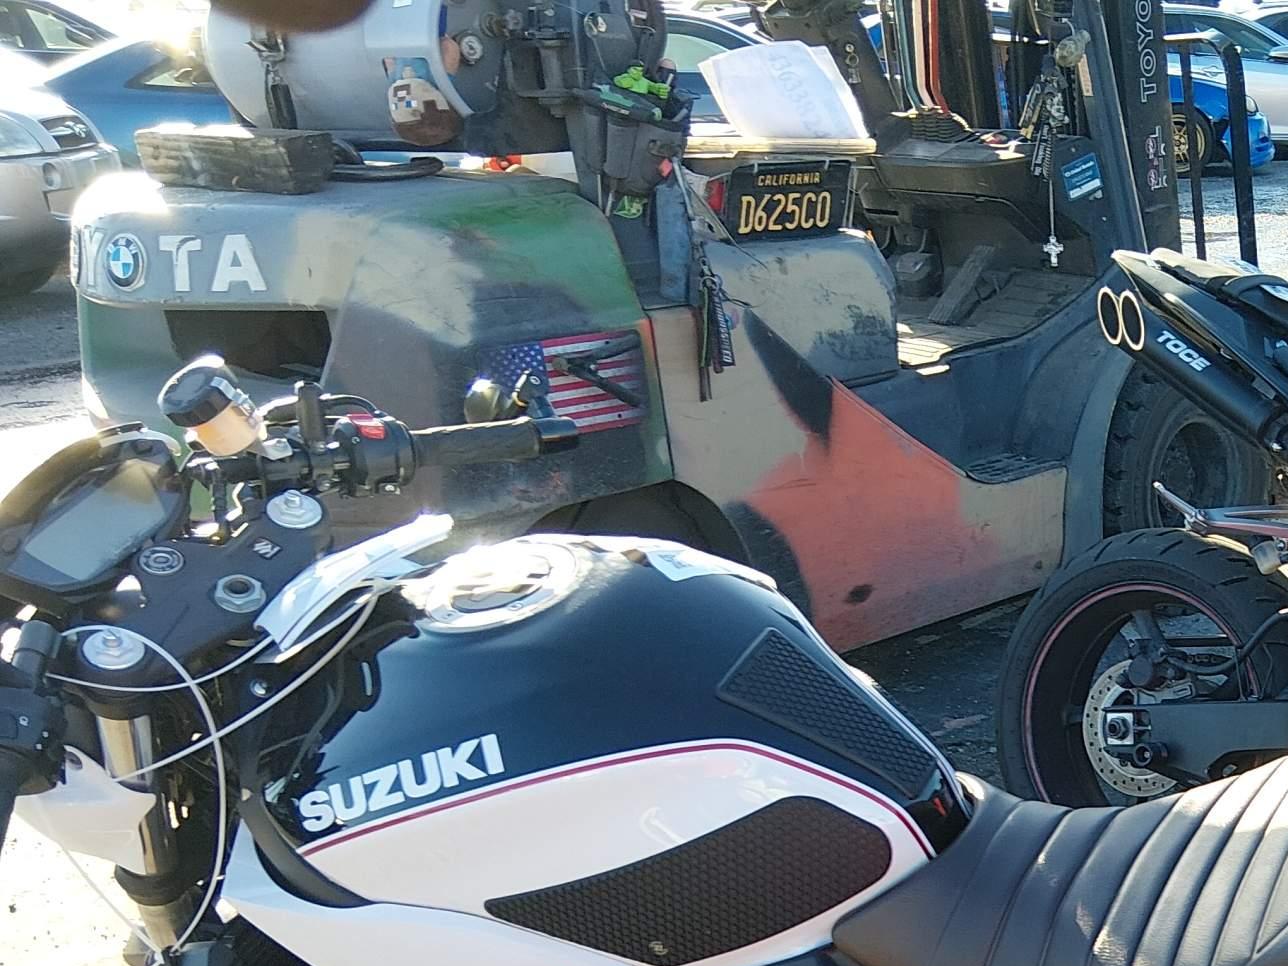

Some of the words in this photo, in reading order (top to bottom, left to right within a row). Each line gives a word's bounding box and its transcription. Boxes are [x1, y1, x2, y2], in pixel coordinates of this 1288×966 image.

[758, 172, 821, 186] CALIFORNIA
[1156, 330, 1212, 372] TOCE
[299, 733, 505, 832] SUZUKI
